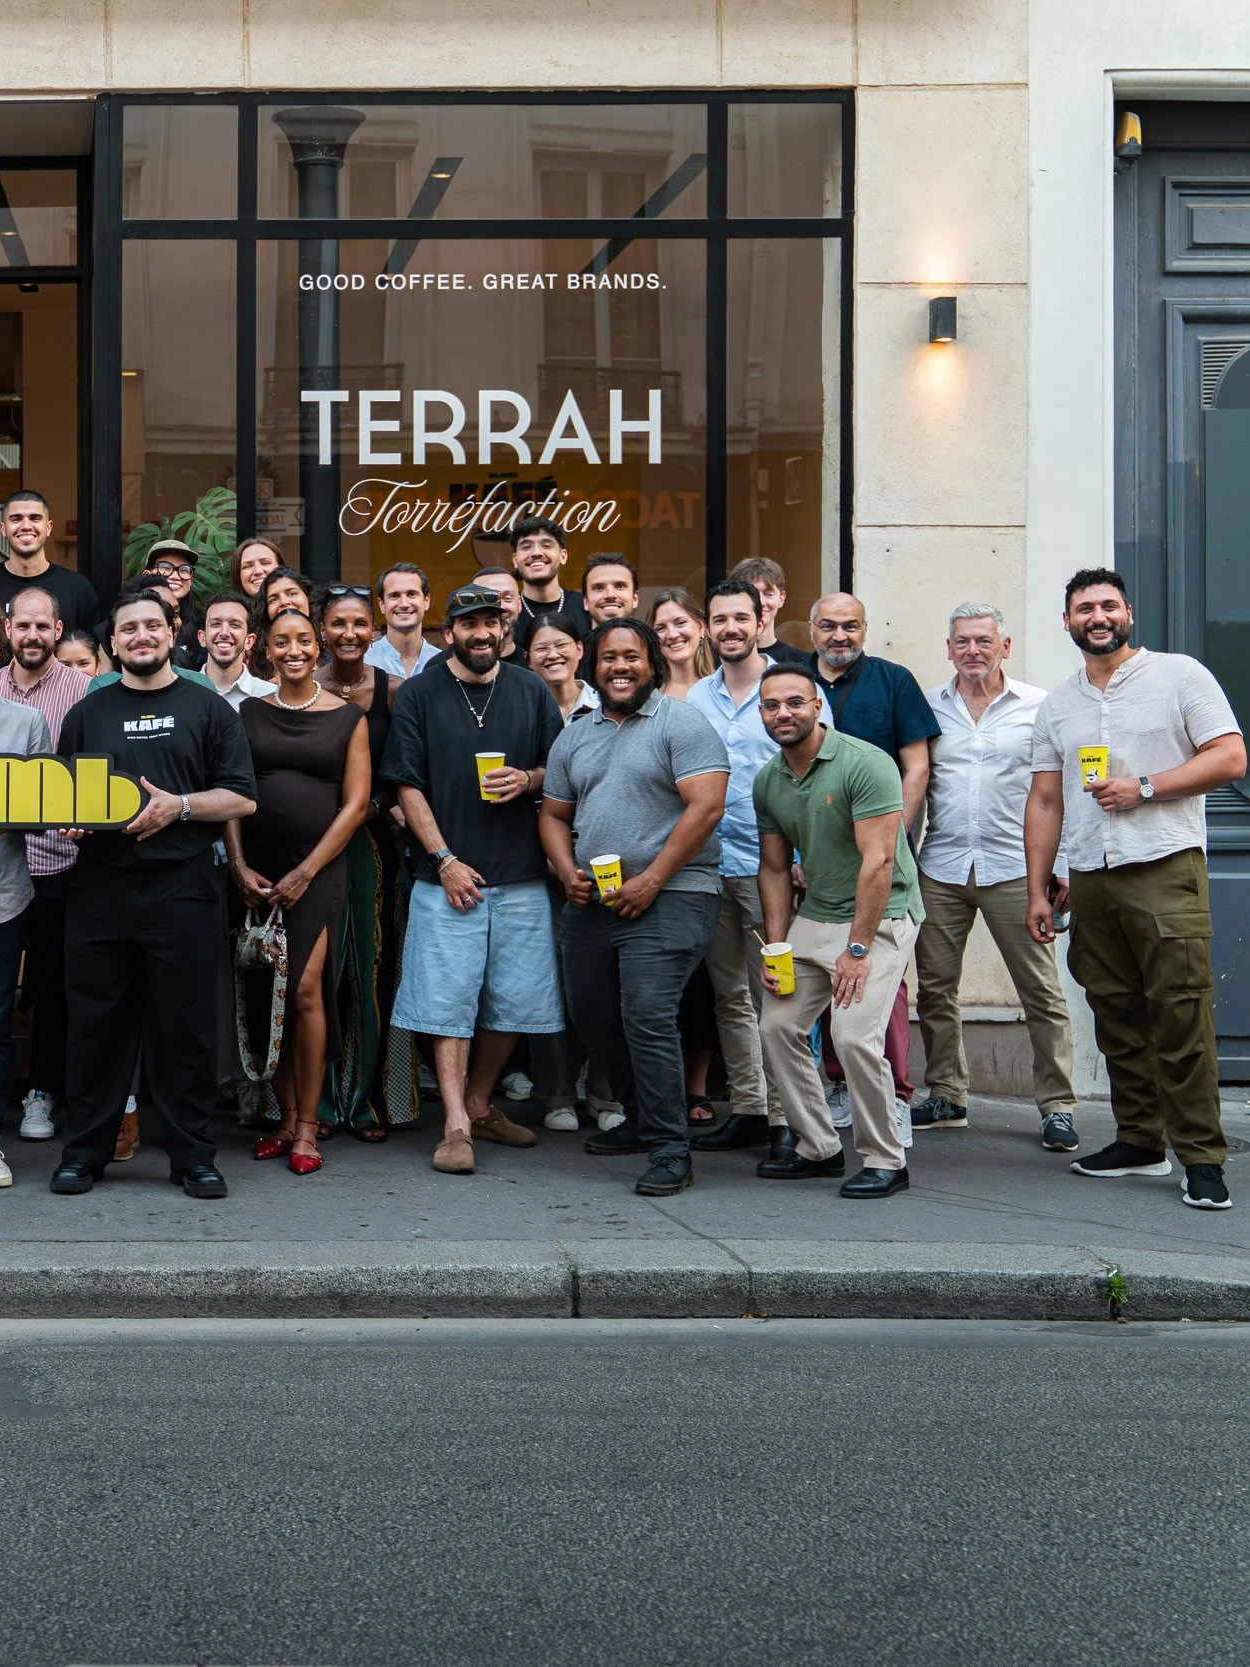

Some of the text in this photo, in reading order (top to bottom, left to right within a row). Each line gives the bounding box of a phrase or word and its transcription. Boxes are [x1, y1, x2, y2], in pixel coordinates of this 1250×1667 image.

[299, 273, 667, 291] GOOD COFFEE. GREAT BRANDS.
[301, 388, 662, 465] TERRAH
[339, 478, 621, 554] Torréfaction
[124, 715, 175, 732] KAFÉ
